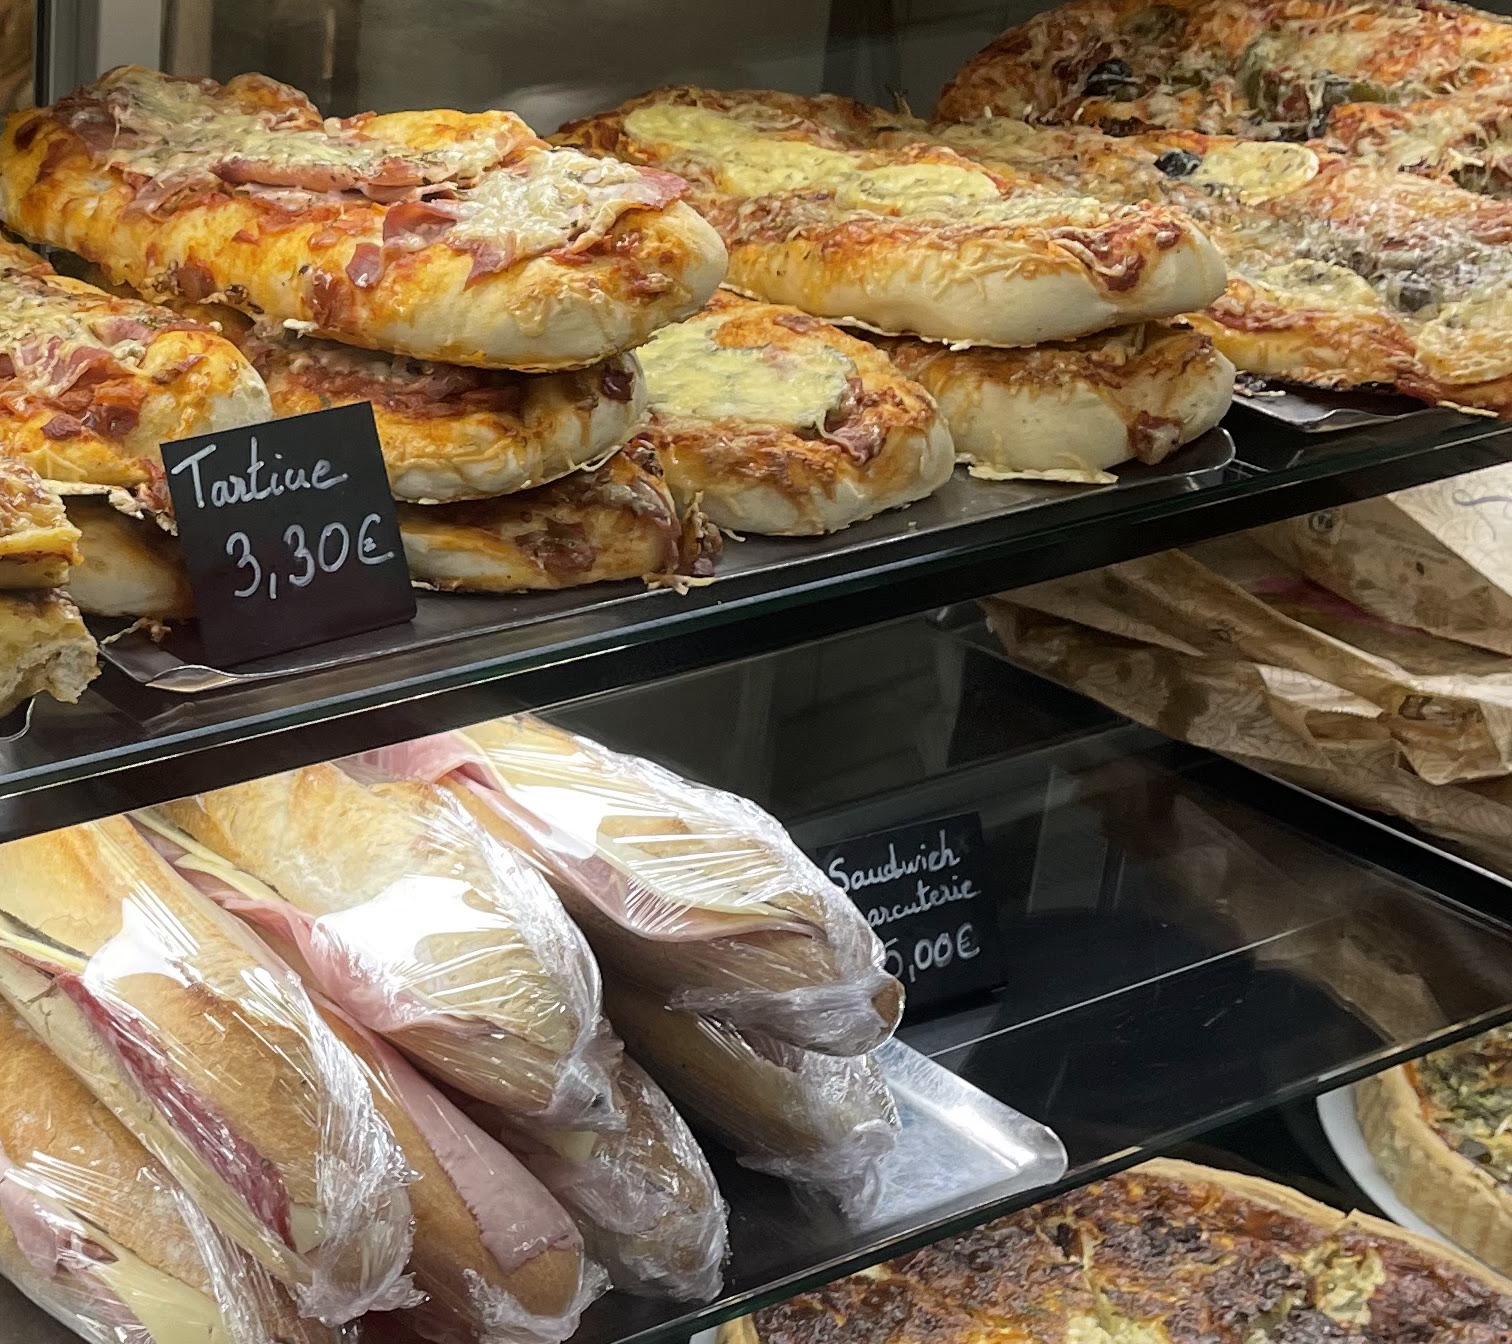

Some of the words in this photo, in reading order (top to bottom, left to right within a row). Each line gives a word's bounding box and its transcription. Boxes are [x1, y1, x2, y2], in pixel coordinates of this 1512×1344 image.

[171, 436, 348, 508] Tartine
[226, 513, 394, 599] 3,30€
[828, 829, 960, 892] Sandwich
[866, 875, 982, 928] arcuterie
[884, 922, 981, 983] 5,00€
